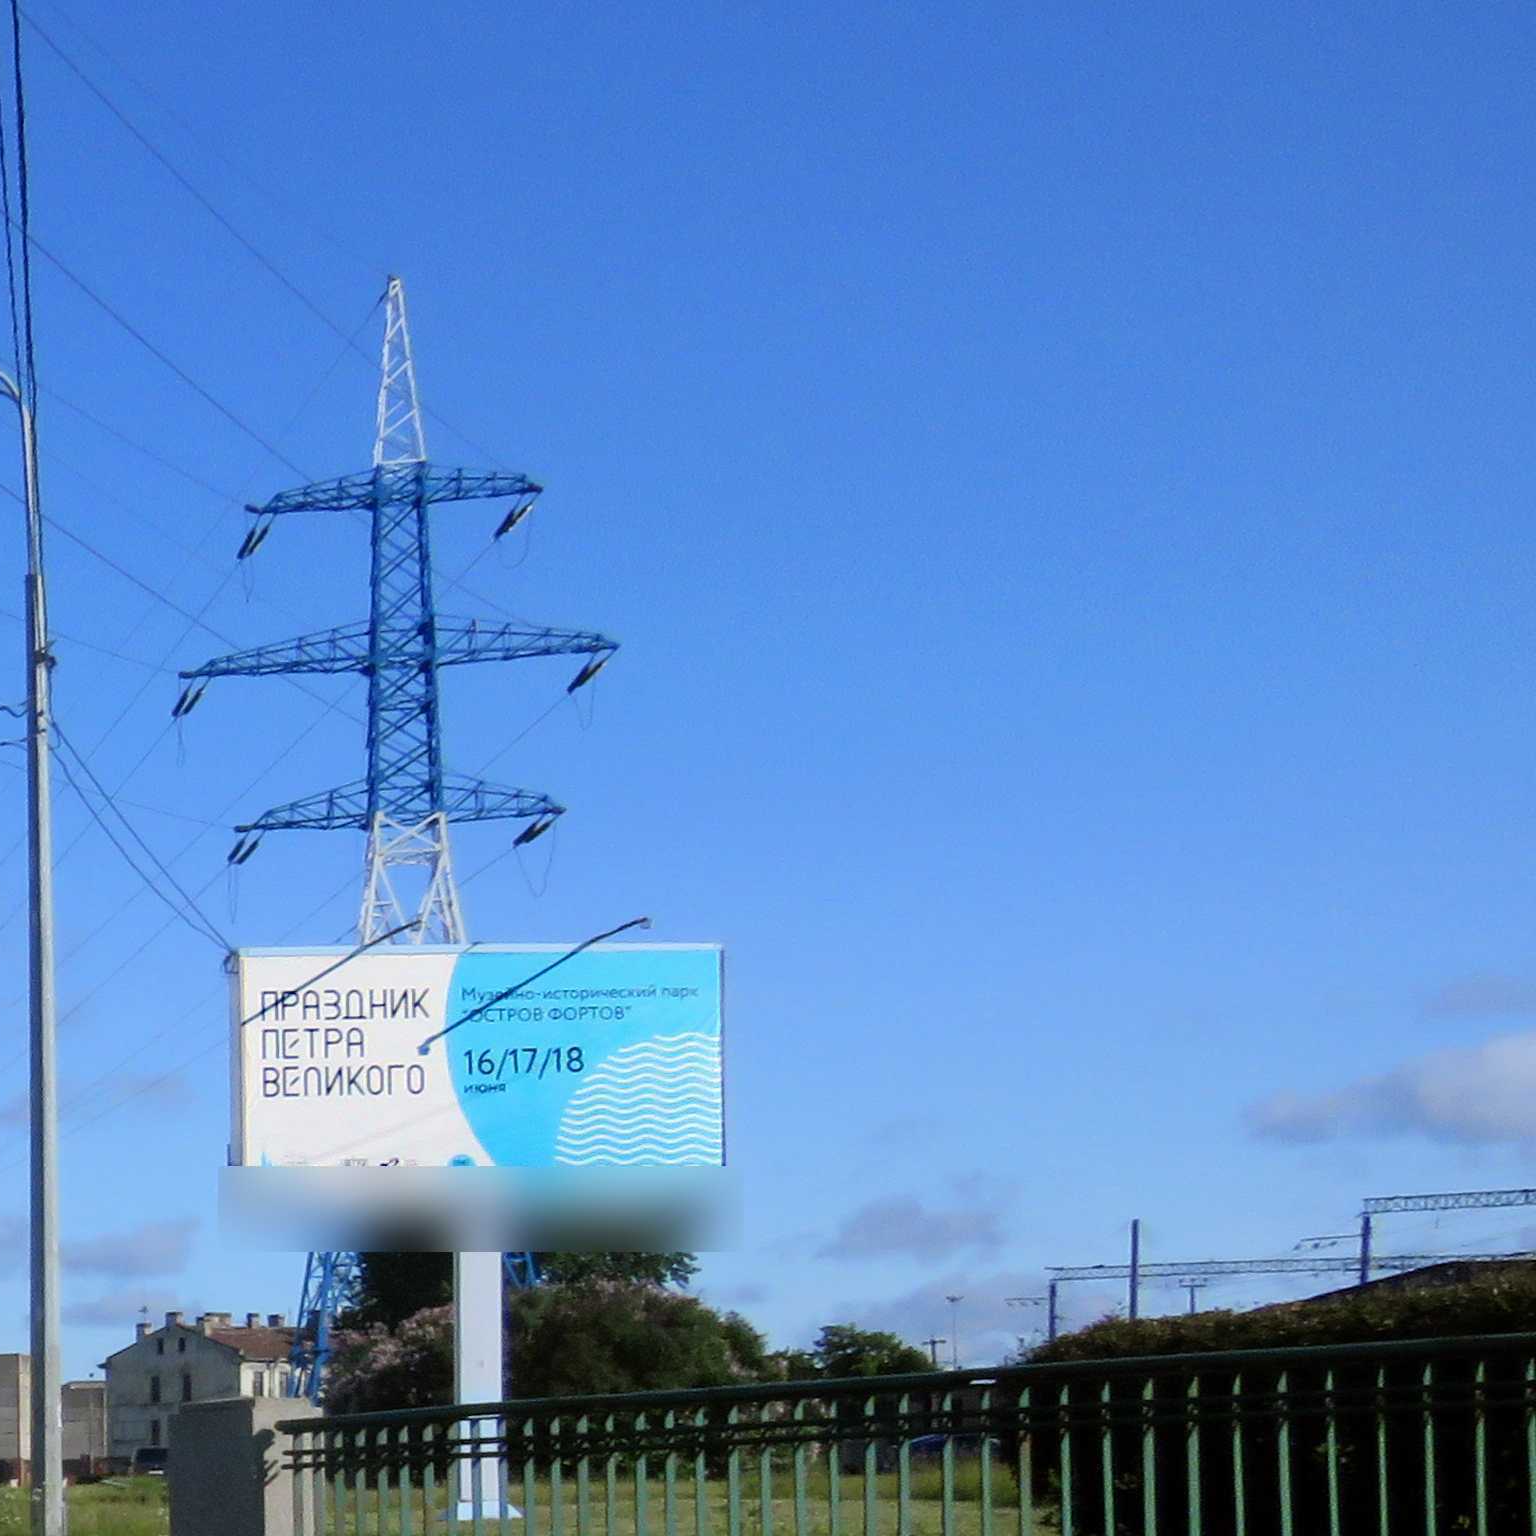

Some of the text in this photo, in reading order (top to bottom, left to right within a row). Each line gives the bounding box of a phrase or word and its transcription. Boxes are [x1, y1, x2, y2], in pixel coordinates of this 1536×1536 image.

[261, 988, 430, 1021] ПРАЗДНИК
[661, 986, 699, 1003] парк
[262, 1027, 365, 1059] ПЕТРА
[464, 1046, 585, 1080] 16/17/18
[262, 1064, 426, 1098] ВЕЛИКОГО
[464, 1083, 506, 1095] июня
